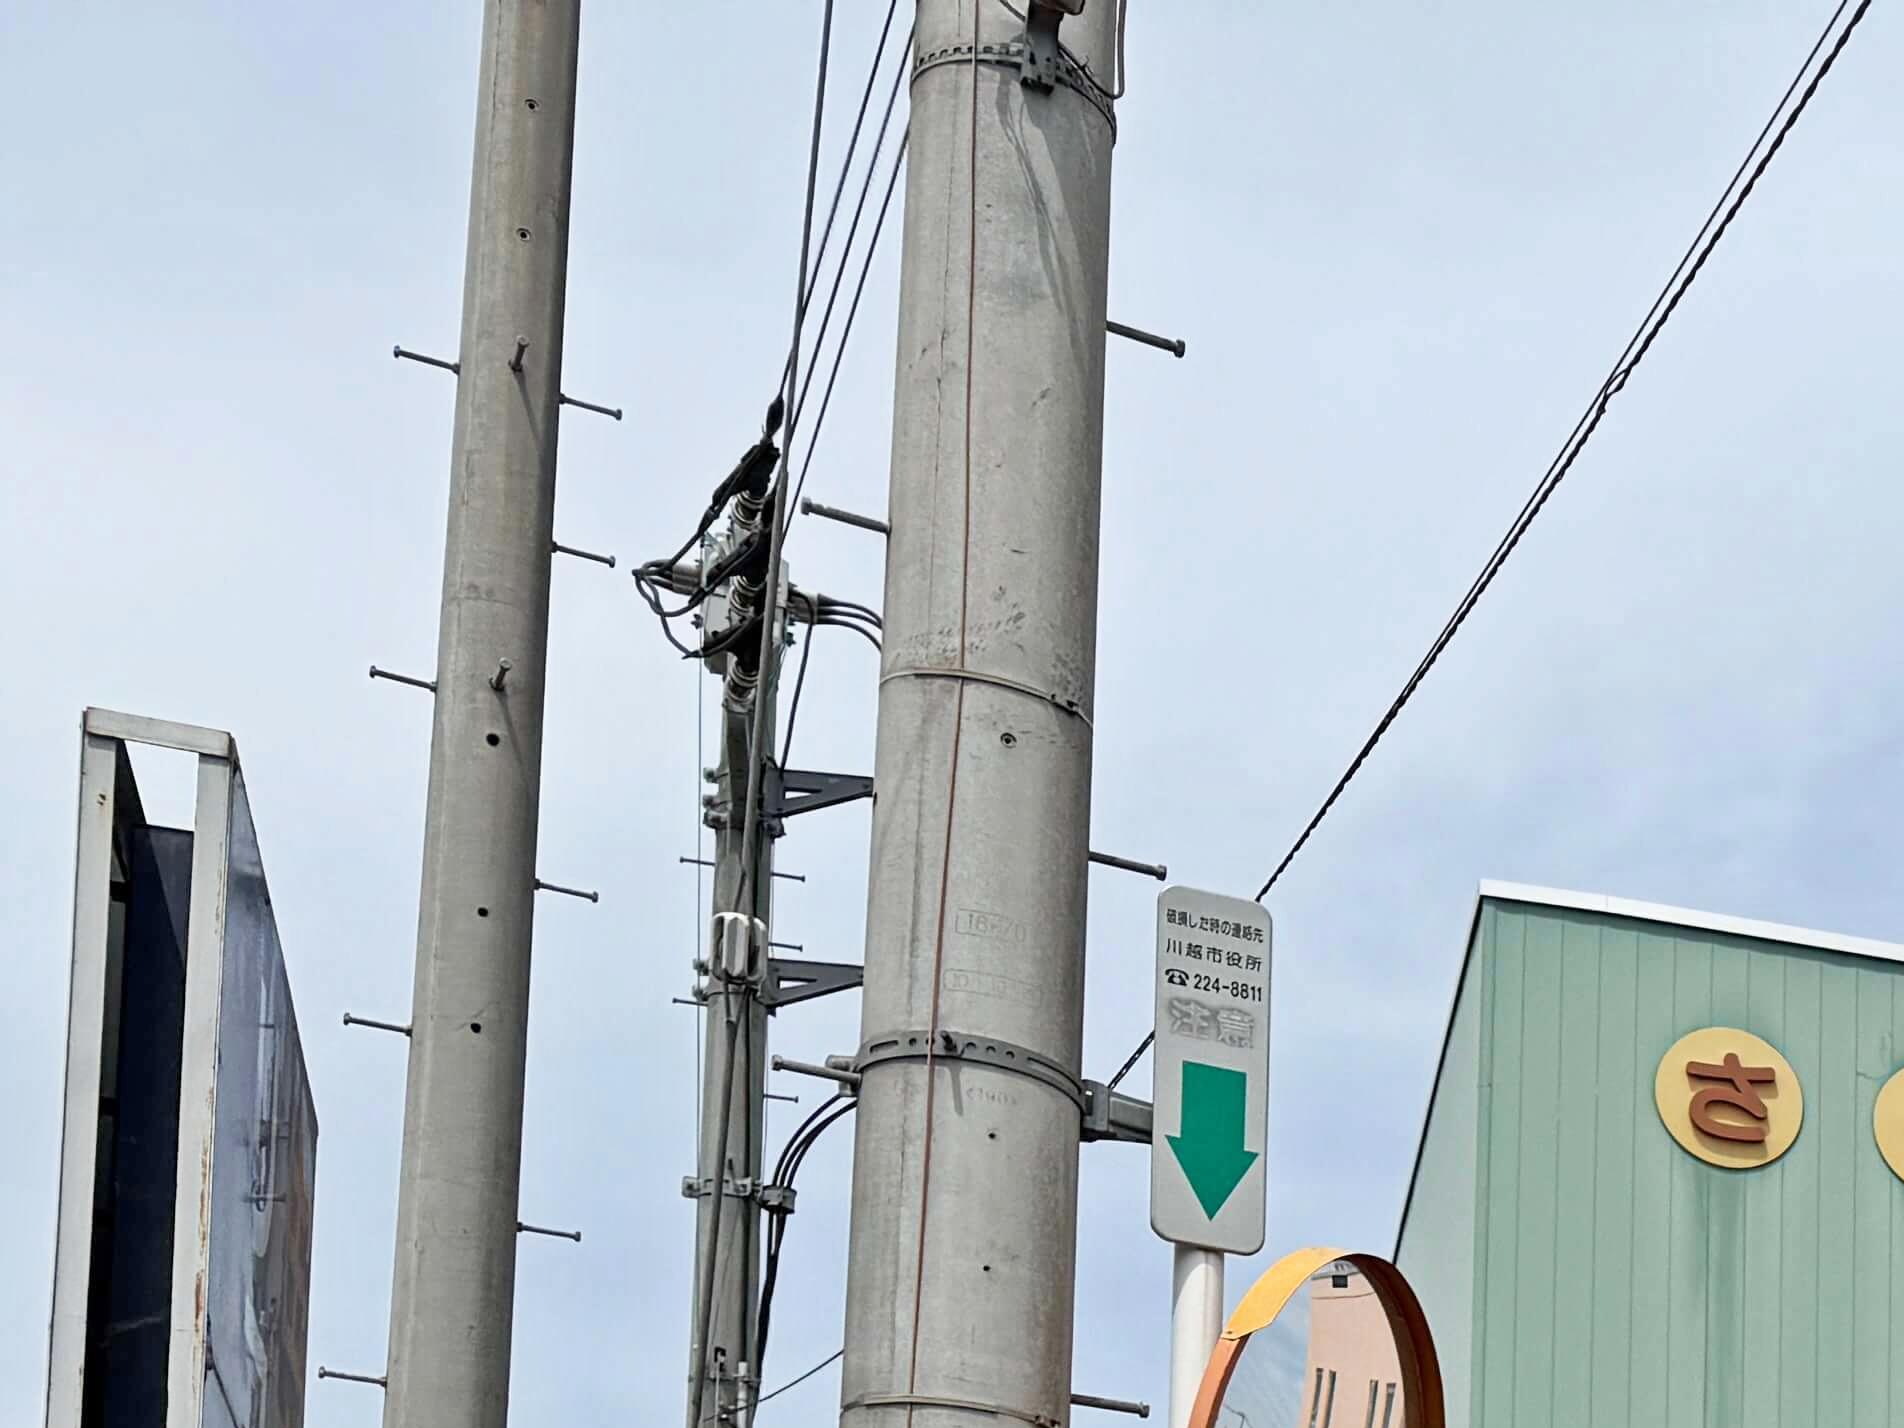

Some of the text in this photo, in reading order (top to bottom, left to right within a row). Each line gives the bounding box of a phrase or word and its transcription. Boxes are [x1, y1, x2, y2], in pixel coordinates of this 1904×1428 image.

[1165, 938, 1263, 973] 川越市役所
[1193, 973, 1263, 1002] 224-8811
[1169, 997, 1255, 1049] 注意
